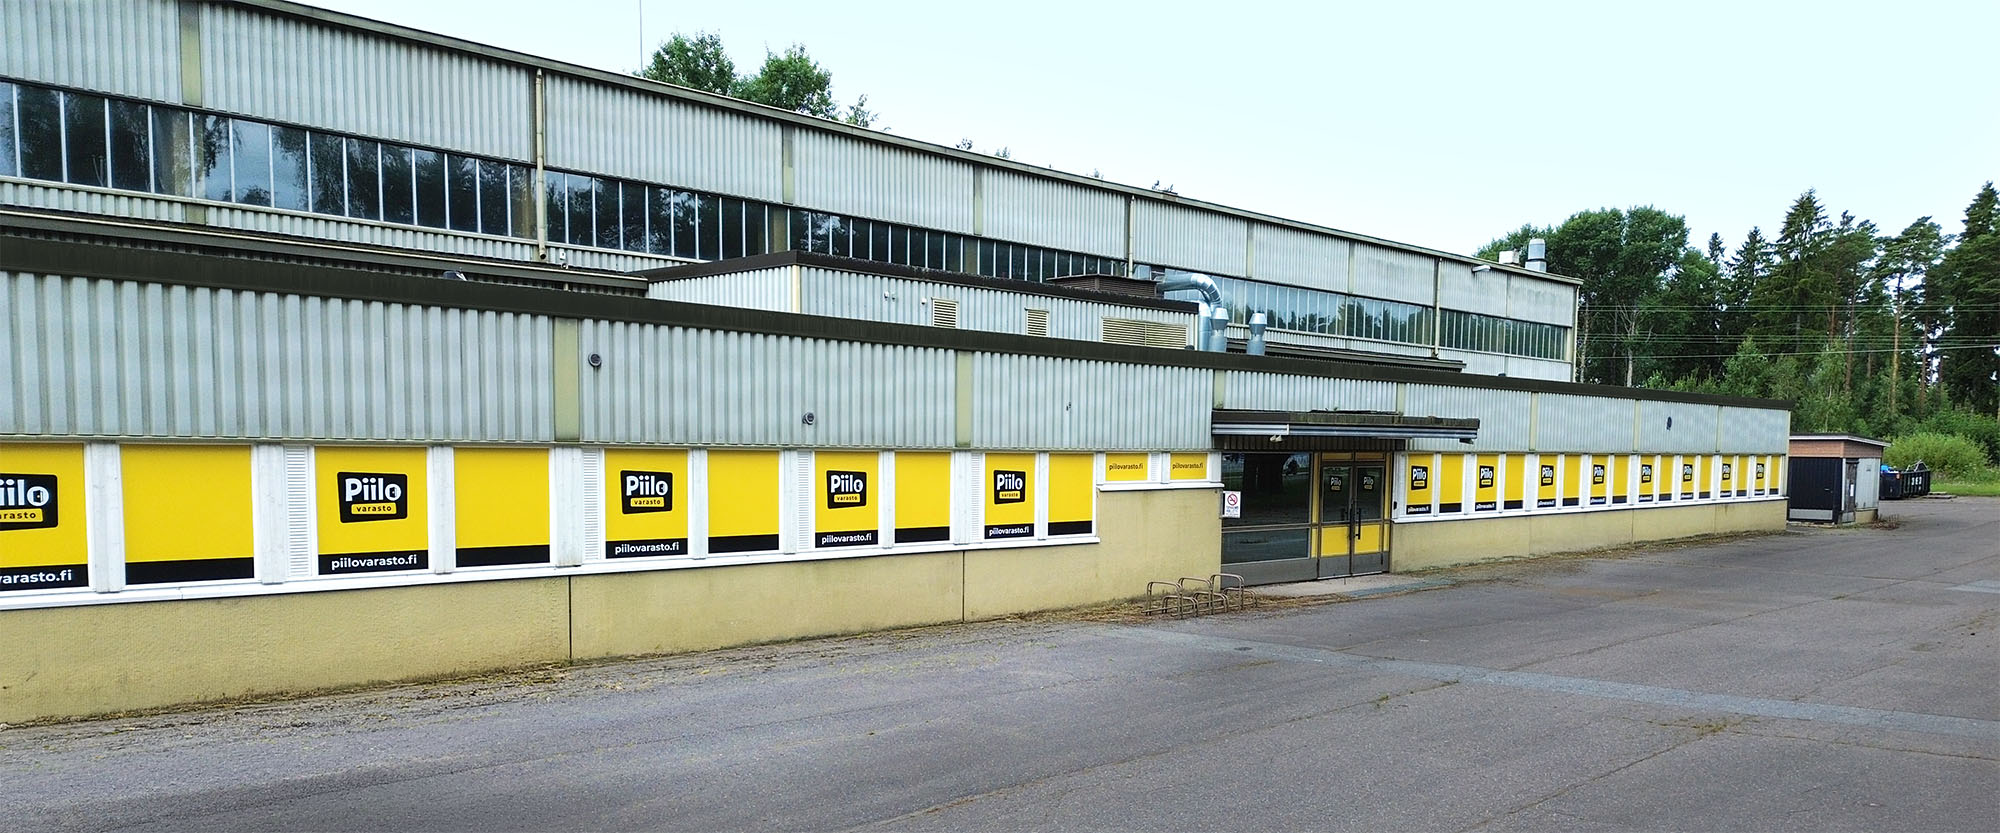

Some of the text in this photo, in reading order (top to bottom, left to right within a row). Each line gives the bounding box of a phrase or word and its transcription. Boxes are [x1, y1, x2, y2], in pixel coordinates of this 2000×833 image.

[1109, 462, 1144, 471] piilovarasto.fi
[345, 477, 401, 502] Piilo
[625, 475, 668, 496] Piilo
[830, 474, 863, 493] Piilo
[996, 473, 1023, 491] Piilo
[0, 511, 36, 519] rasto
[821, 533, 872, 545] piilovarasto.fi
[988, 526, 1030, 537] piilovarasto.fi
[614, 541, 680, 555] piilovarasto.fi
[331, 554, 417, 571] piilovarasto.fi
